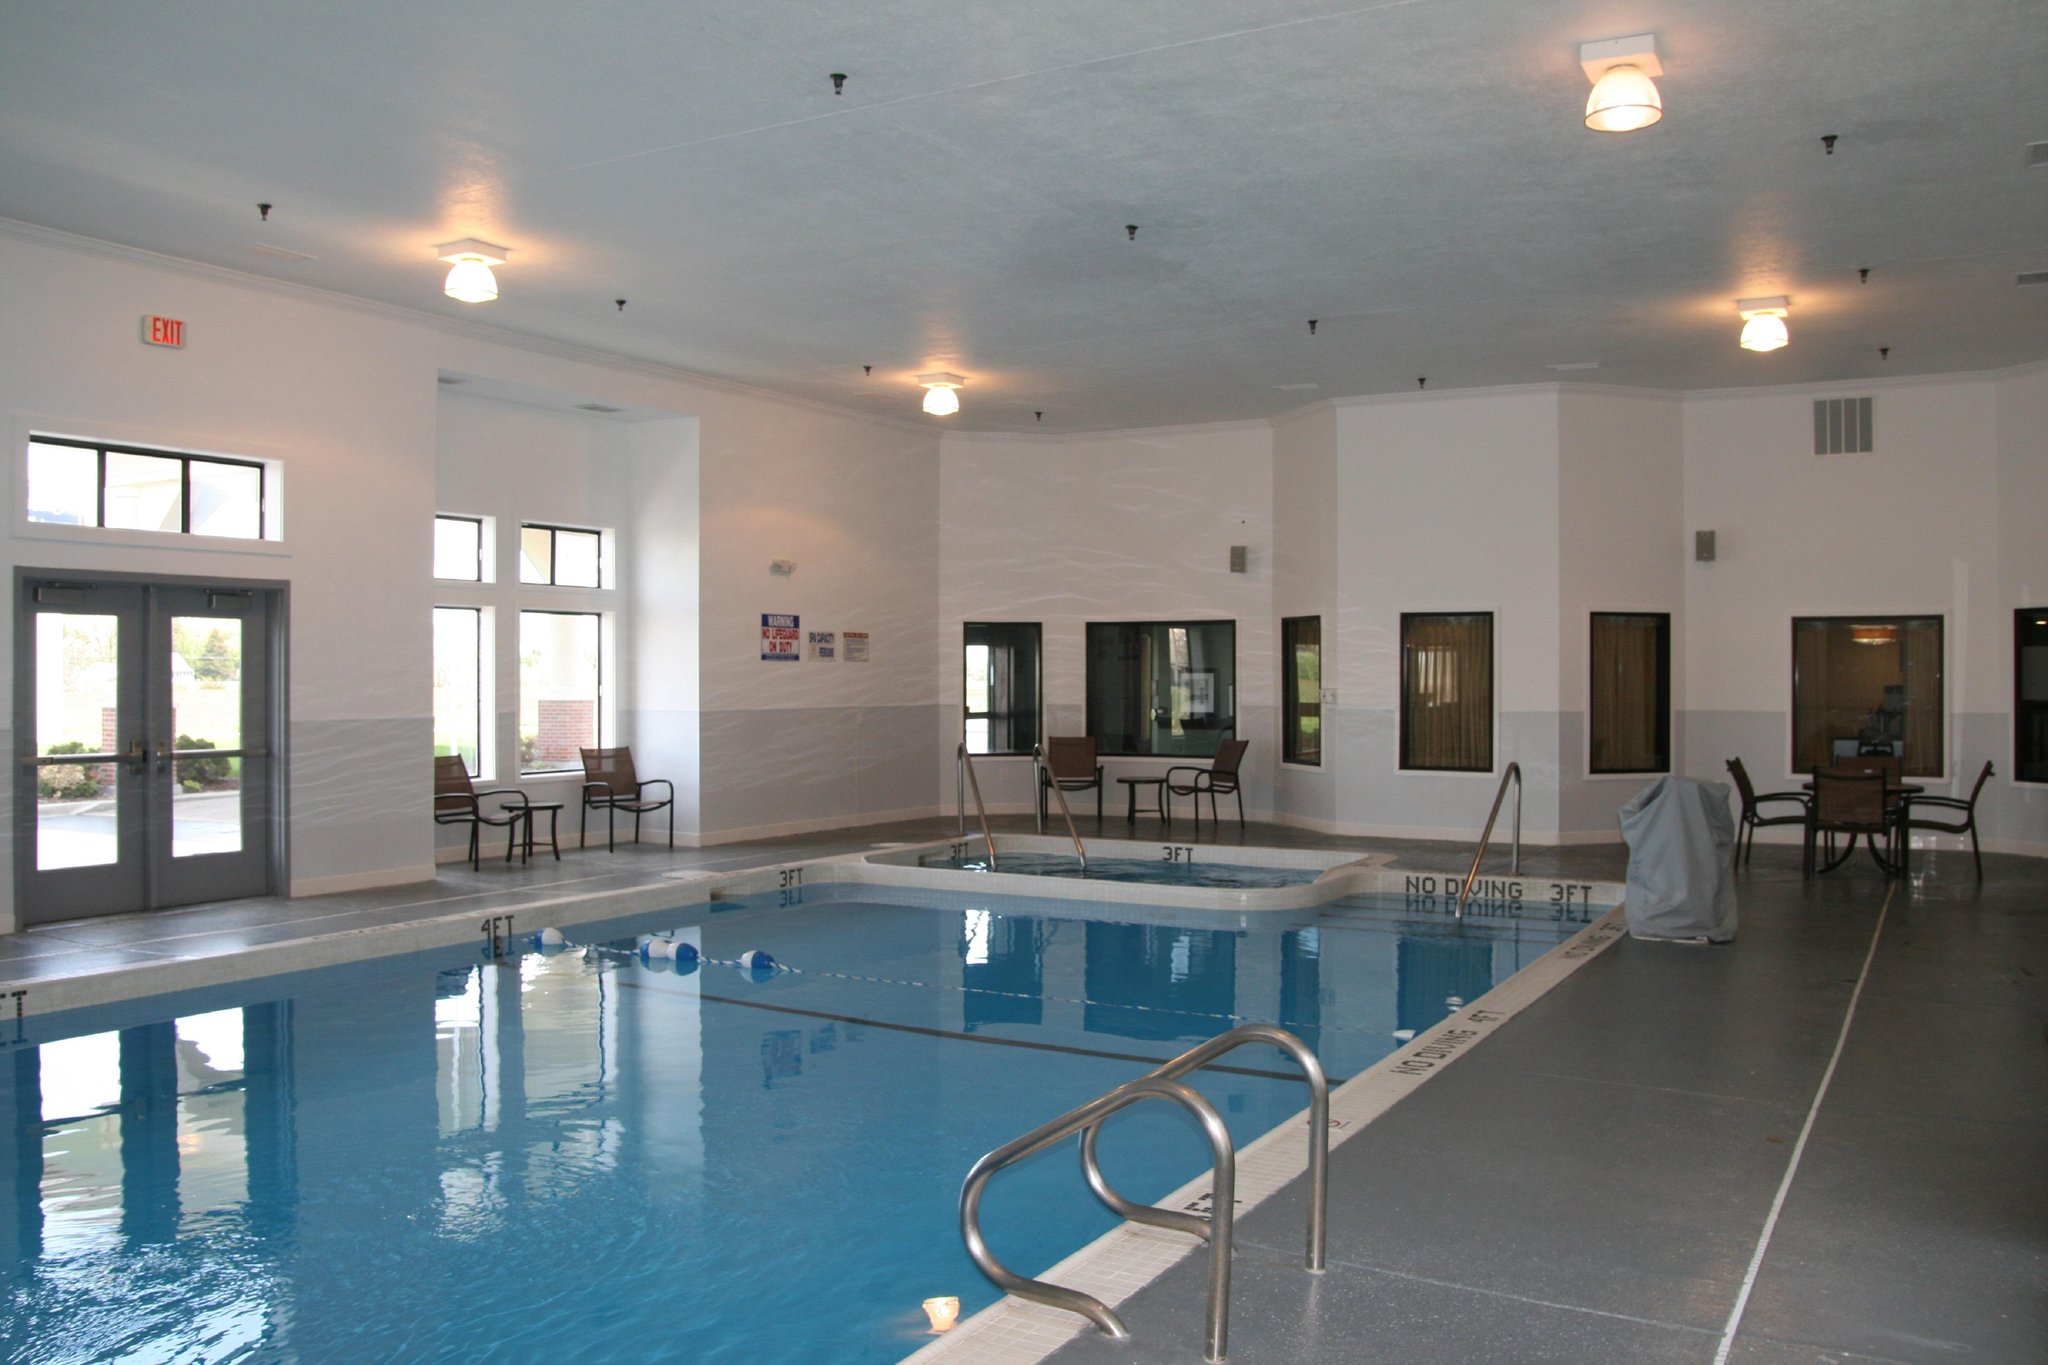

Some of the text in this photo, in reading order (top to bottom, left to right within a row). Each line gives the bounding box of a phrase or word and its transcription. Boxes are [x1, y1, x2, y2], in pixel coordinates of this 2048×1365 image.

[152, 316, 182, 346] EXIT
[767, 615, 794, 628] WARNING
[761, 628, 799, 640] NO LIFEGUARD
[769, 641, 792, 653] ON DUTY
[1162, 846, 1194, 863] 3FT
[779, 868, 803, 888] 3FT
[1405, 876, 1436, 894] NO
[1550, 884, 1592, 903] 3FT
[480, 915, 515, 940] 4FT
[1389, 1060, 1435, 1076] NO
[1412, 1030, 1478, 1060] DIVING
